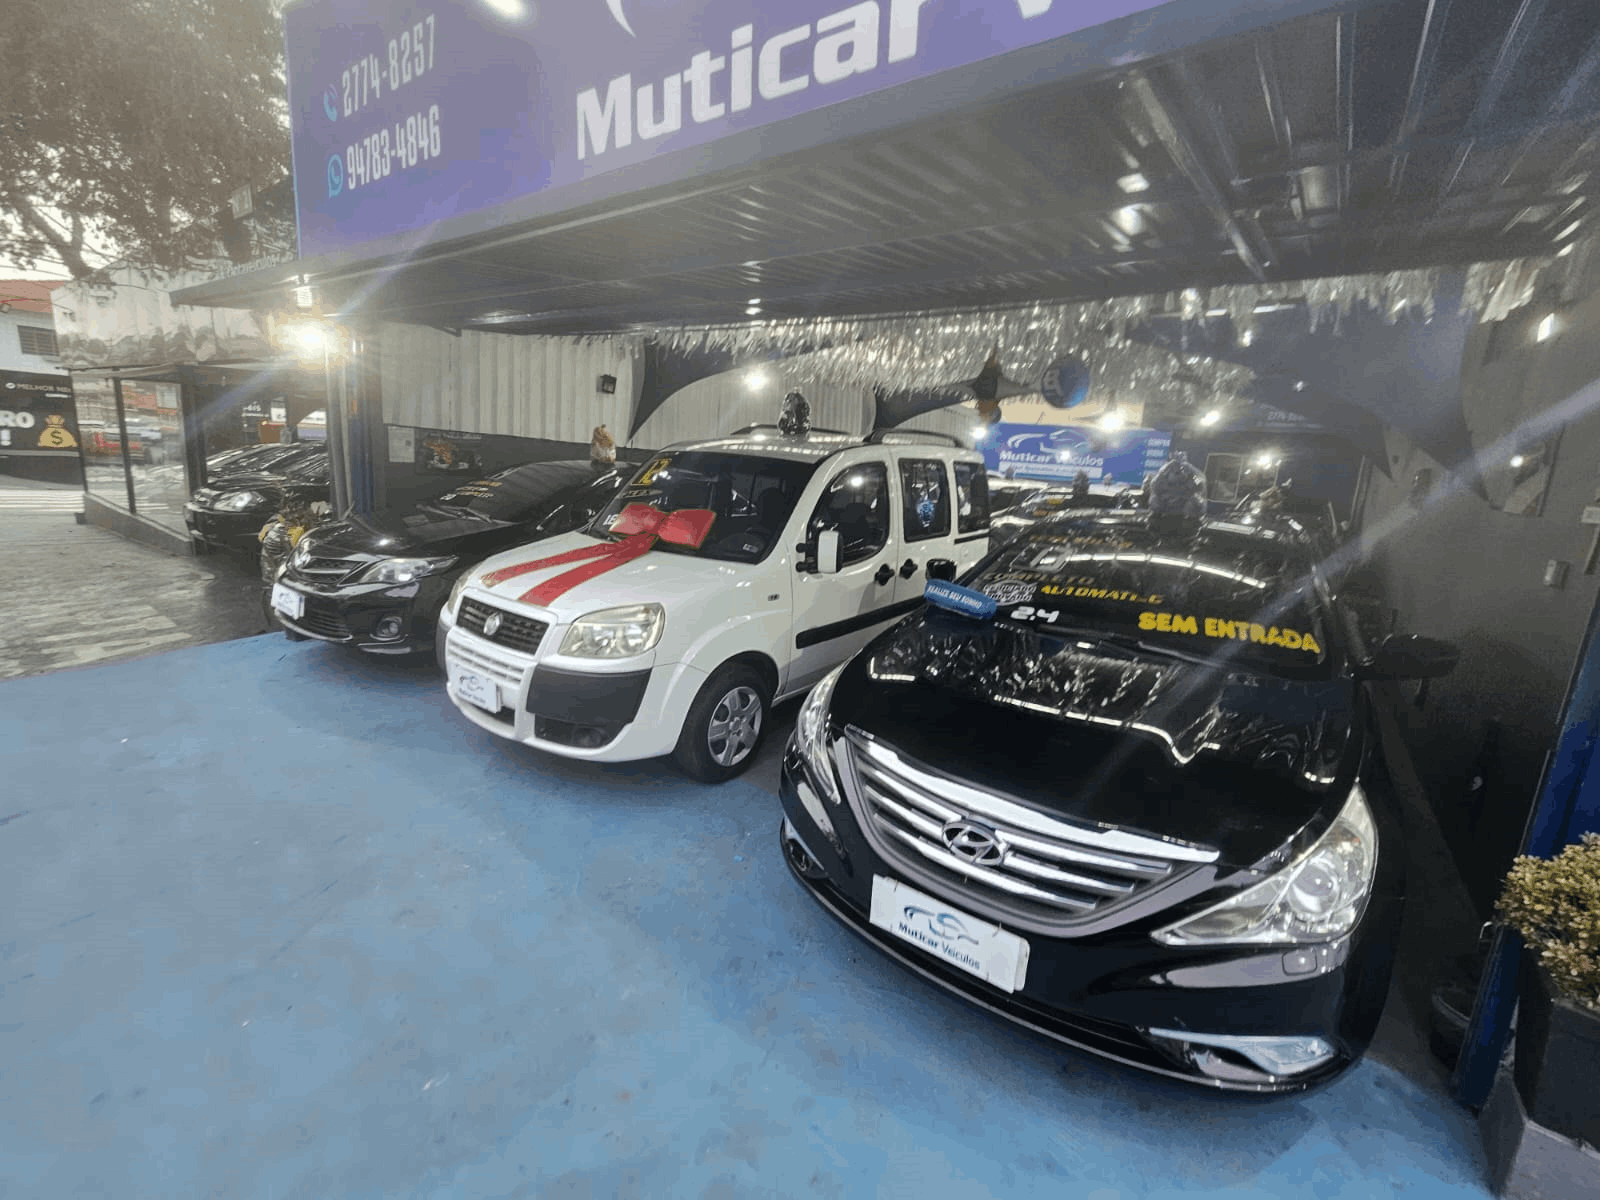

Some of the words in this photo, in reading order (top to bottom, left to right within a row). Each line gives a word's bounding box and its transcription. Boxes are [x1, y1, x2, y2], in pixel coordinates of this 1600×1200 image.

[342, 13, 435, 118] 2774-8257
[576, 0, 930, 161] Muticar
[346, 104, 441, 190] 94783-4846
[999, 450, 1052, 464] Muticar
[1010, 606, 1060, 623] 2.4
[1138, 612, 1198, 635] SEM
[1204, 617, 1321, 653] ENTRADA
[898, 920, 938, 949] Muticar
